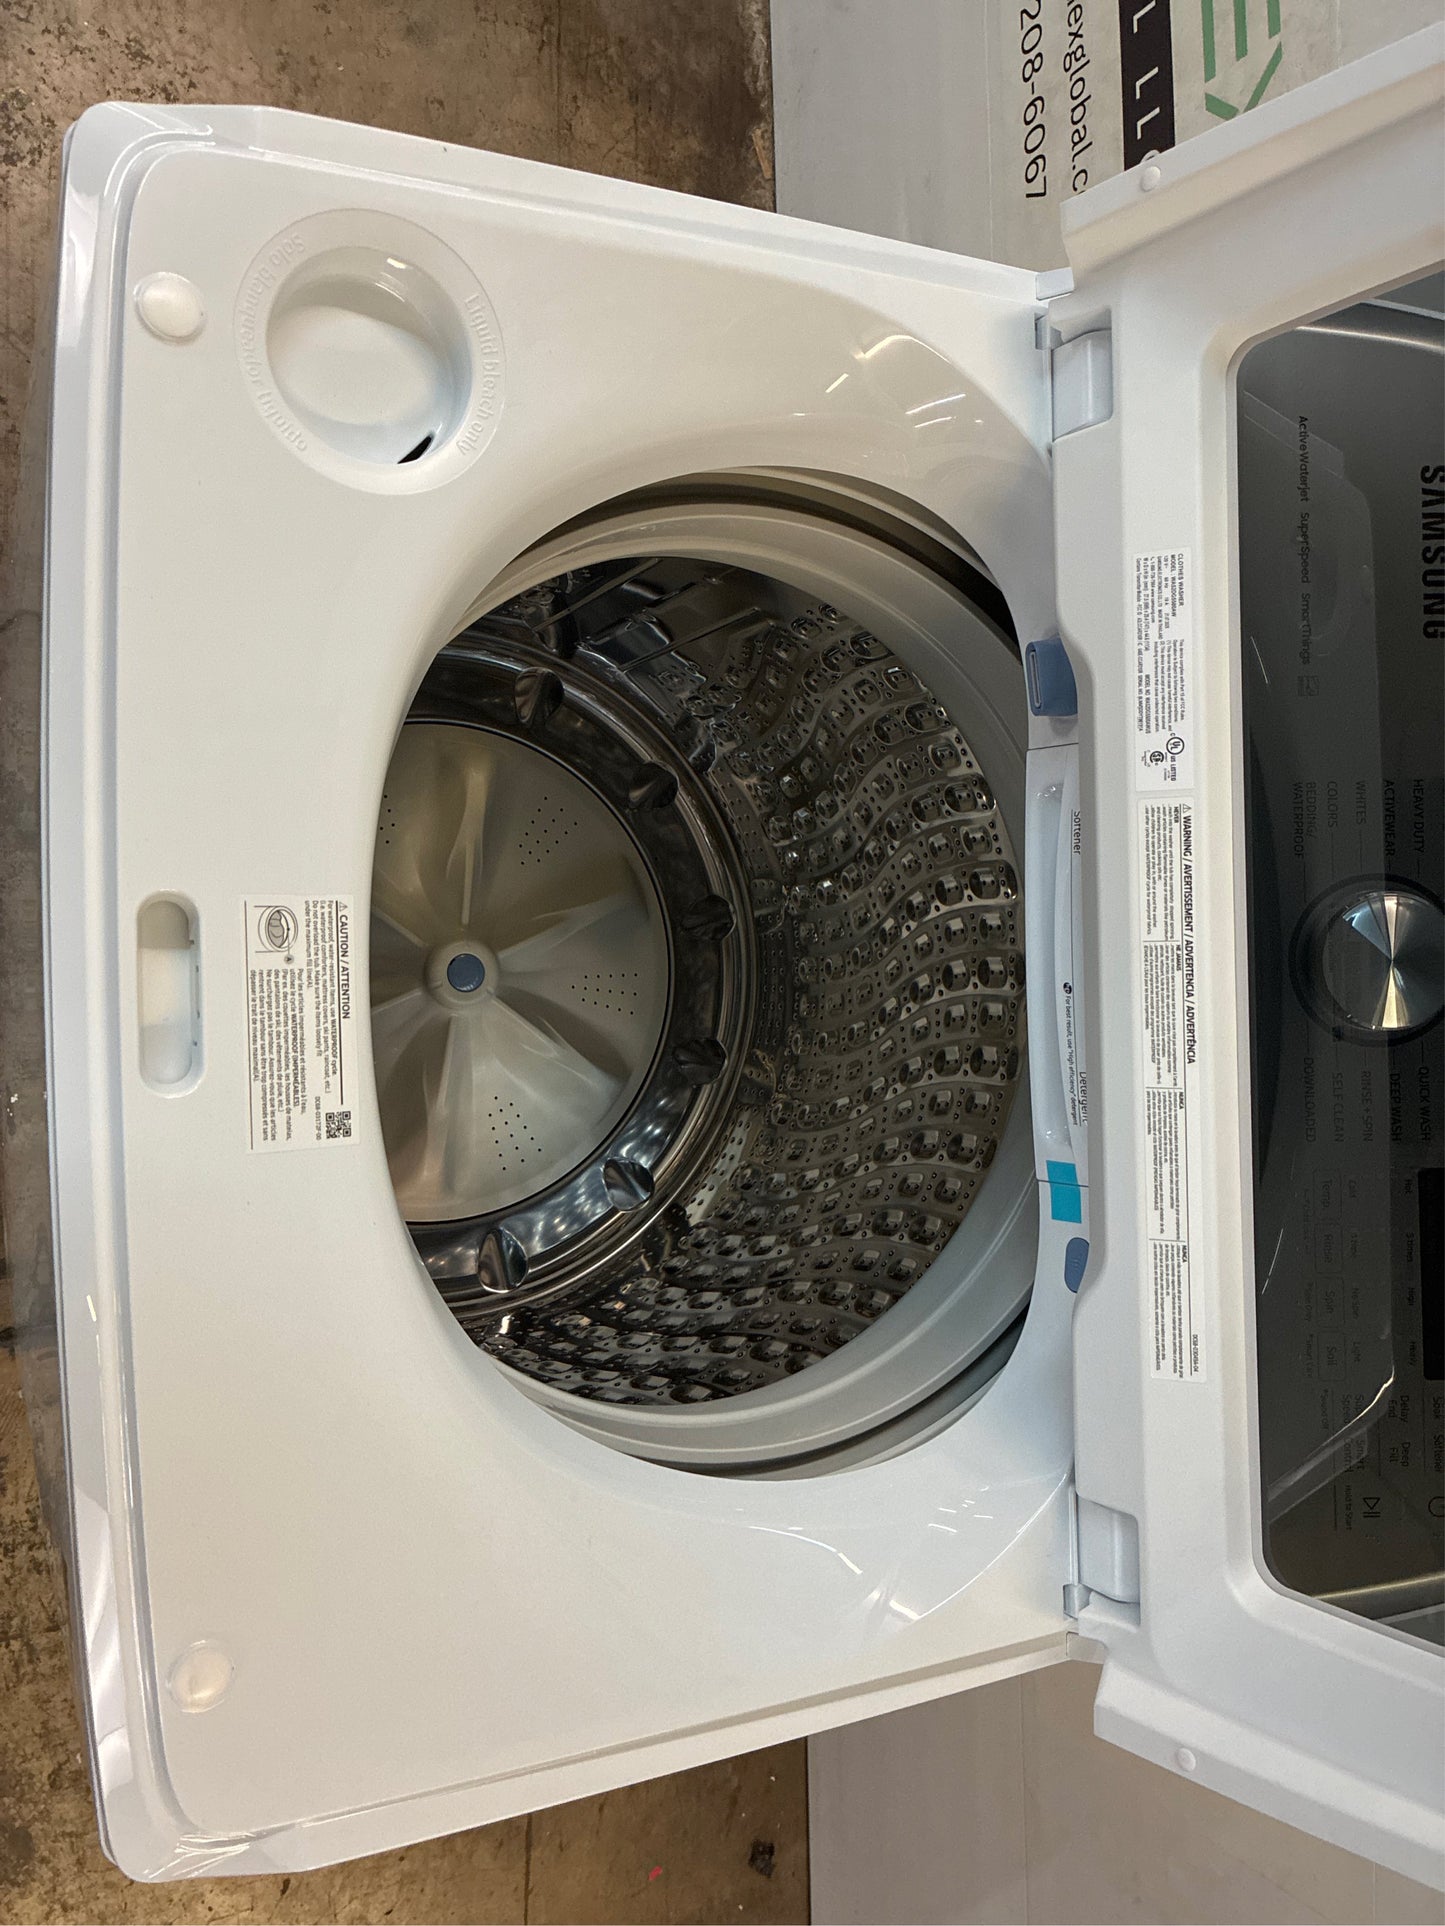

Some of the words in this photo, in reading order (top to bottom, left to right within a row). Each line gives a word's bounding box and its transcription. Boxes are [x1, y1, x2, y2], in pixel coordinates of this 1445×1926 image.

[1064, 0, 1092, 194] exglobal.c
[1136, 66, 1160, 164] LL
[464, 294, 498, 355] Liquid
[476, 359, 500, 420] bleach
[456, 420, 484, 456] only
[1298, 416, 1310, 502] ActiveWaterjet
[1299, 512, 1311, 584] SuperSpeed
[1421, 466, 1445, 640] SAMSUNG
[1299, 592, 1312, 665] SmartThings
[1306, 782, 1317, 838] BEDDING/
[1327, 780, 1338, 828] COLORS
[1356, 780, 1366, 825] WHITES
[1383, 779, 1396, 856] ACTIVEWEAR
[1413, 779, 1424, 819] HEAVY
[1183, 816, 1192, 856] WARNING
[1292, 782, 1304, 860] WATERPROOF
[1413, 822, 1424, 853] DUTY
[312, 900, 319, 909] Do
[1184, 864, 1194, 932] AVERTISSEMENT
[319, 912, 327, 943] waterproof
[340, 915, 348, 958] CAUTION
[266, 969, 272, 978] Ne
[1185, 940, 1195, 998] ADVERTENCIA
[340, 966, 350, 1019] ATTENTION
[314, 1028, 322, 1049] loosely
[1186, 1006, 1197, 1064] ADVERTÊNCIA
[1304, 1057, 1316, 1142] DOWNLOADED
[1332, 1072, 1344, 1100] SELF
[1360, 1071, 1372, 1104] RINSE
[1390, 1073, 1402, 1104] DEEP
[1418, 1066, 1430, 1102] QUICK
[1334, 1103, 1344, 1142] CLEAN
[1362, 1116, 1373, 1142] SPIN
[1390, 1106, 1402, 1142] WASH
[1420, 1106, 1432, 1141] WASH
[1400, 1395, 1410, 1422] Delay
[1400, 1442, 1411, 1467] Deep
